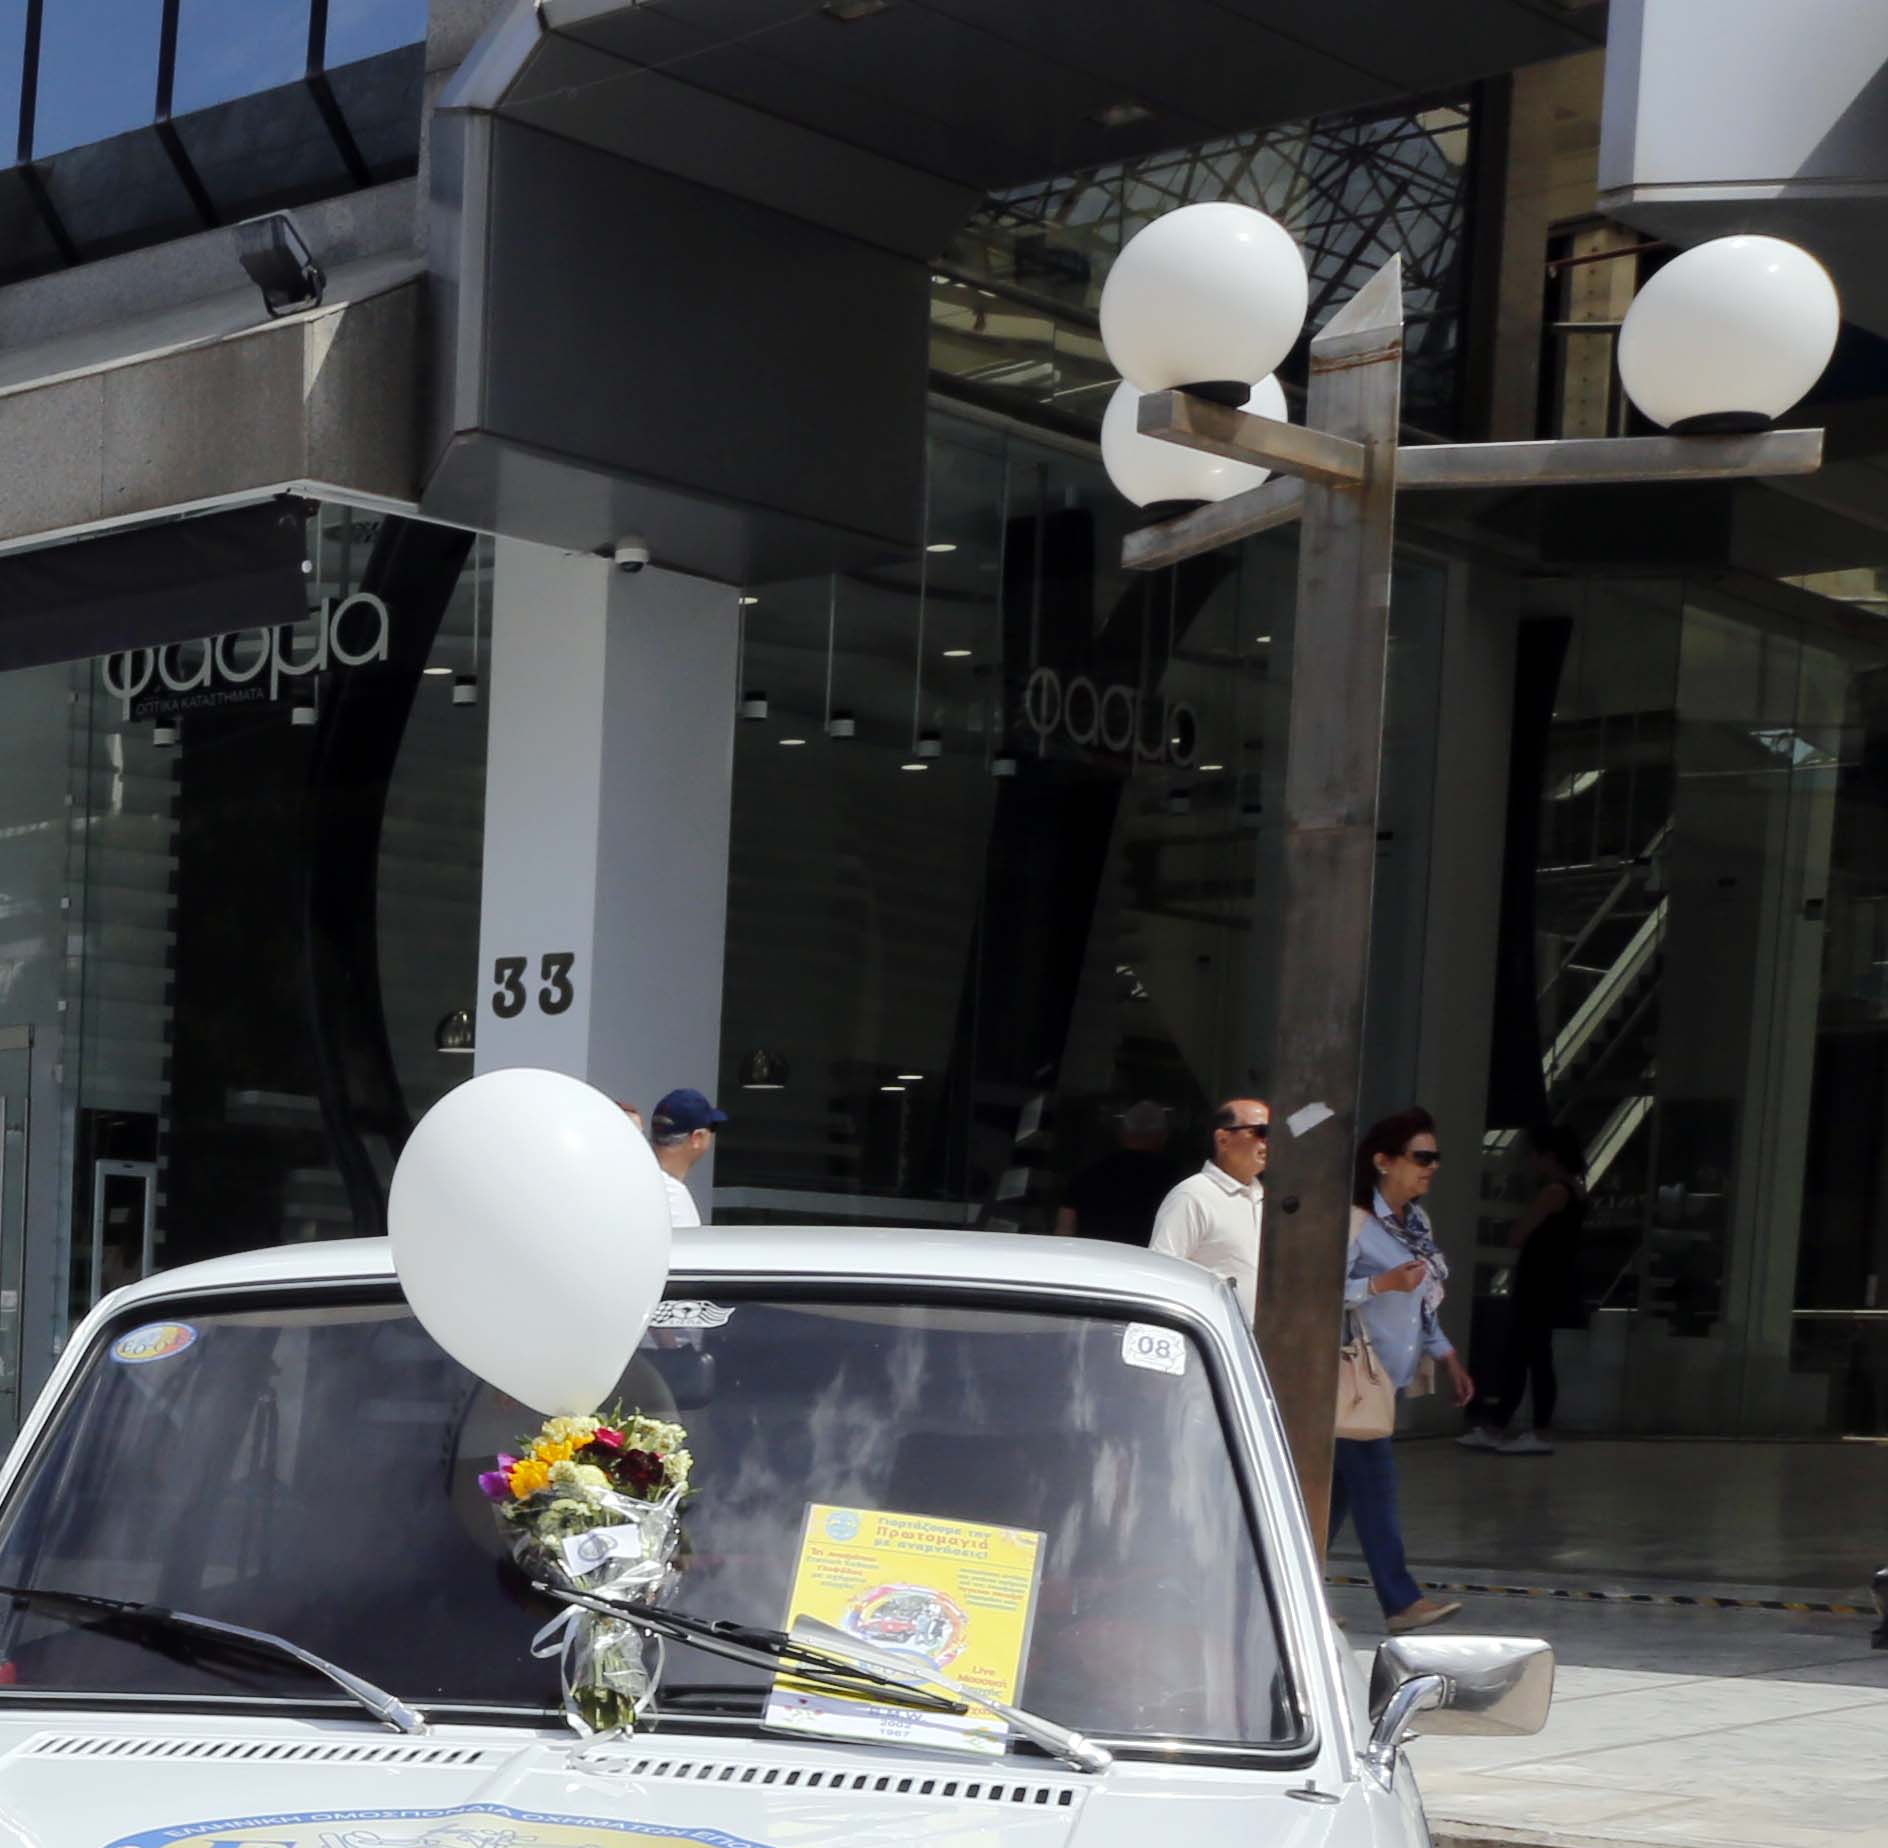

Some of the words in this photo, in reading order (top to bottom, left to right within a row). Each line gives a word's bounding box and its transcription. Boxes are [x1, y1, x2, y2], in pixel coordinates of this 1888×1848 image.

[491, 952, 575, 1019] 33
[1137, 1335, 1171, 1359] 08
[876, 1526, 989, 1550] Πρωτομαγιά
[163, 1814, 302, 1839] ΕΛΛΗΝΙΚΗ
